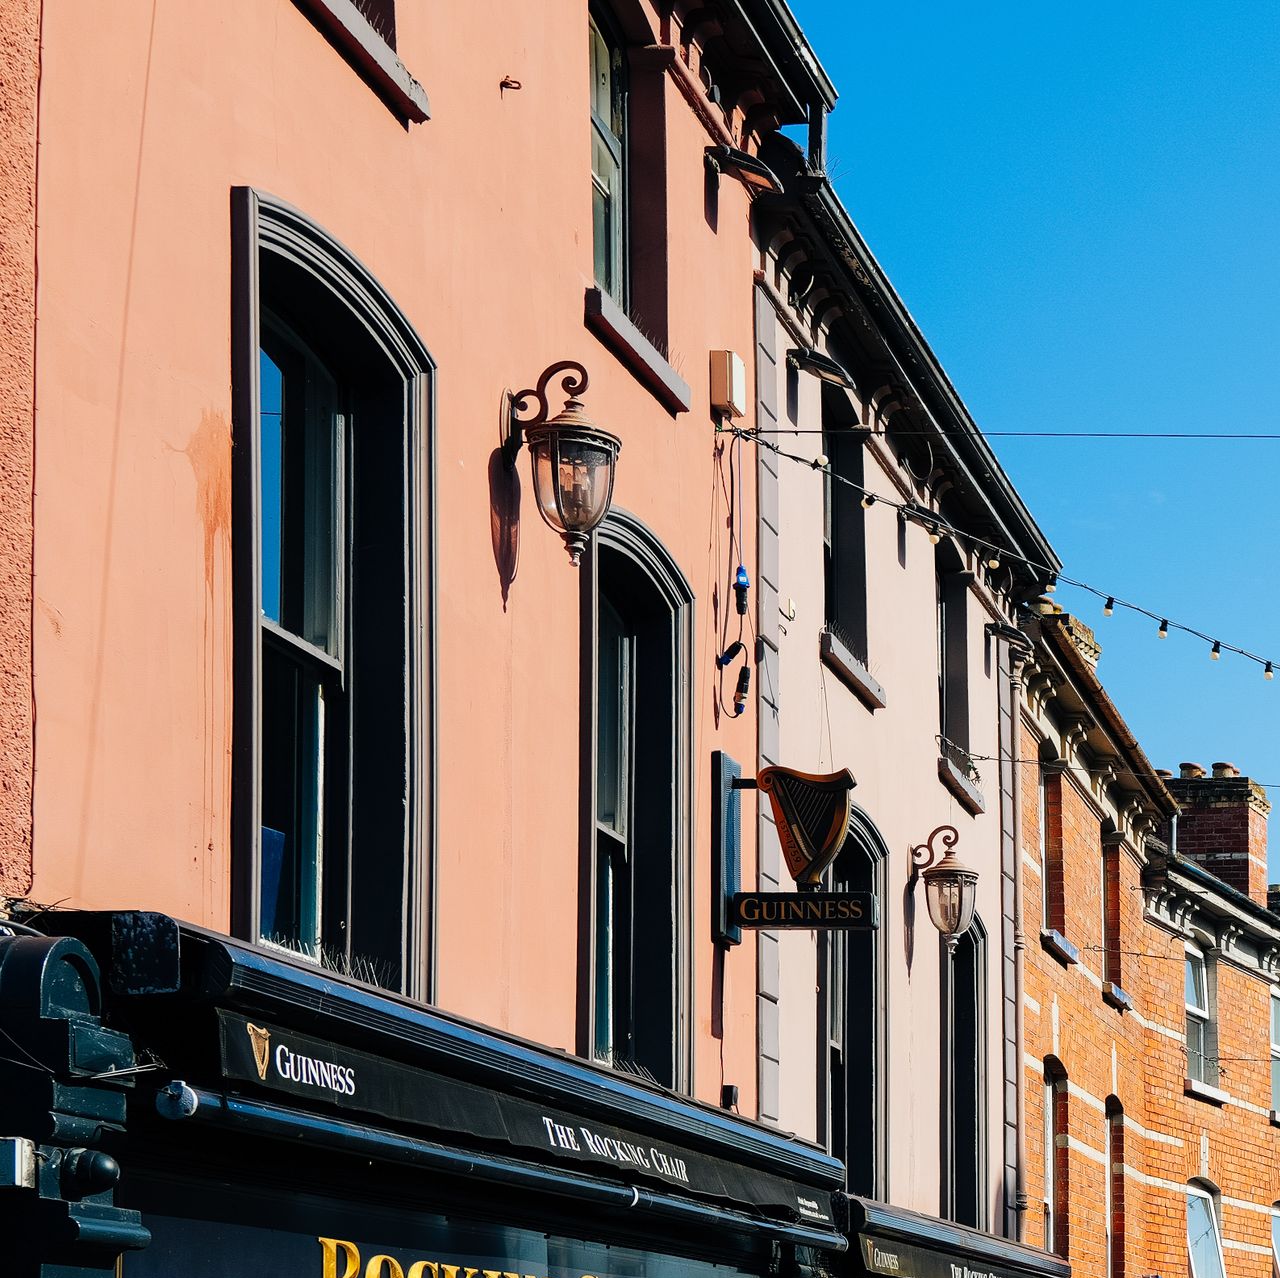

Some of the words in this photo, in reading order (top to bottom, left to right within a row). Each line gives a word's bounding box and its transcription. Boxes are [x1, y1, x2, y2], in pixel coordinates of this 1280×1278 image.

[739, 897, 863, 922] GUINNESS
[275, 1043, 356, 1097] GUINNESS
[541, 1116, 581, 1152] THE
[583, 1126, 649, 1170] ROCKING
[650, 1147, 690, 1184] CHAIR
[873, 1247, 901, 1271] GUINNESS
